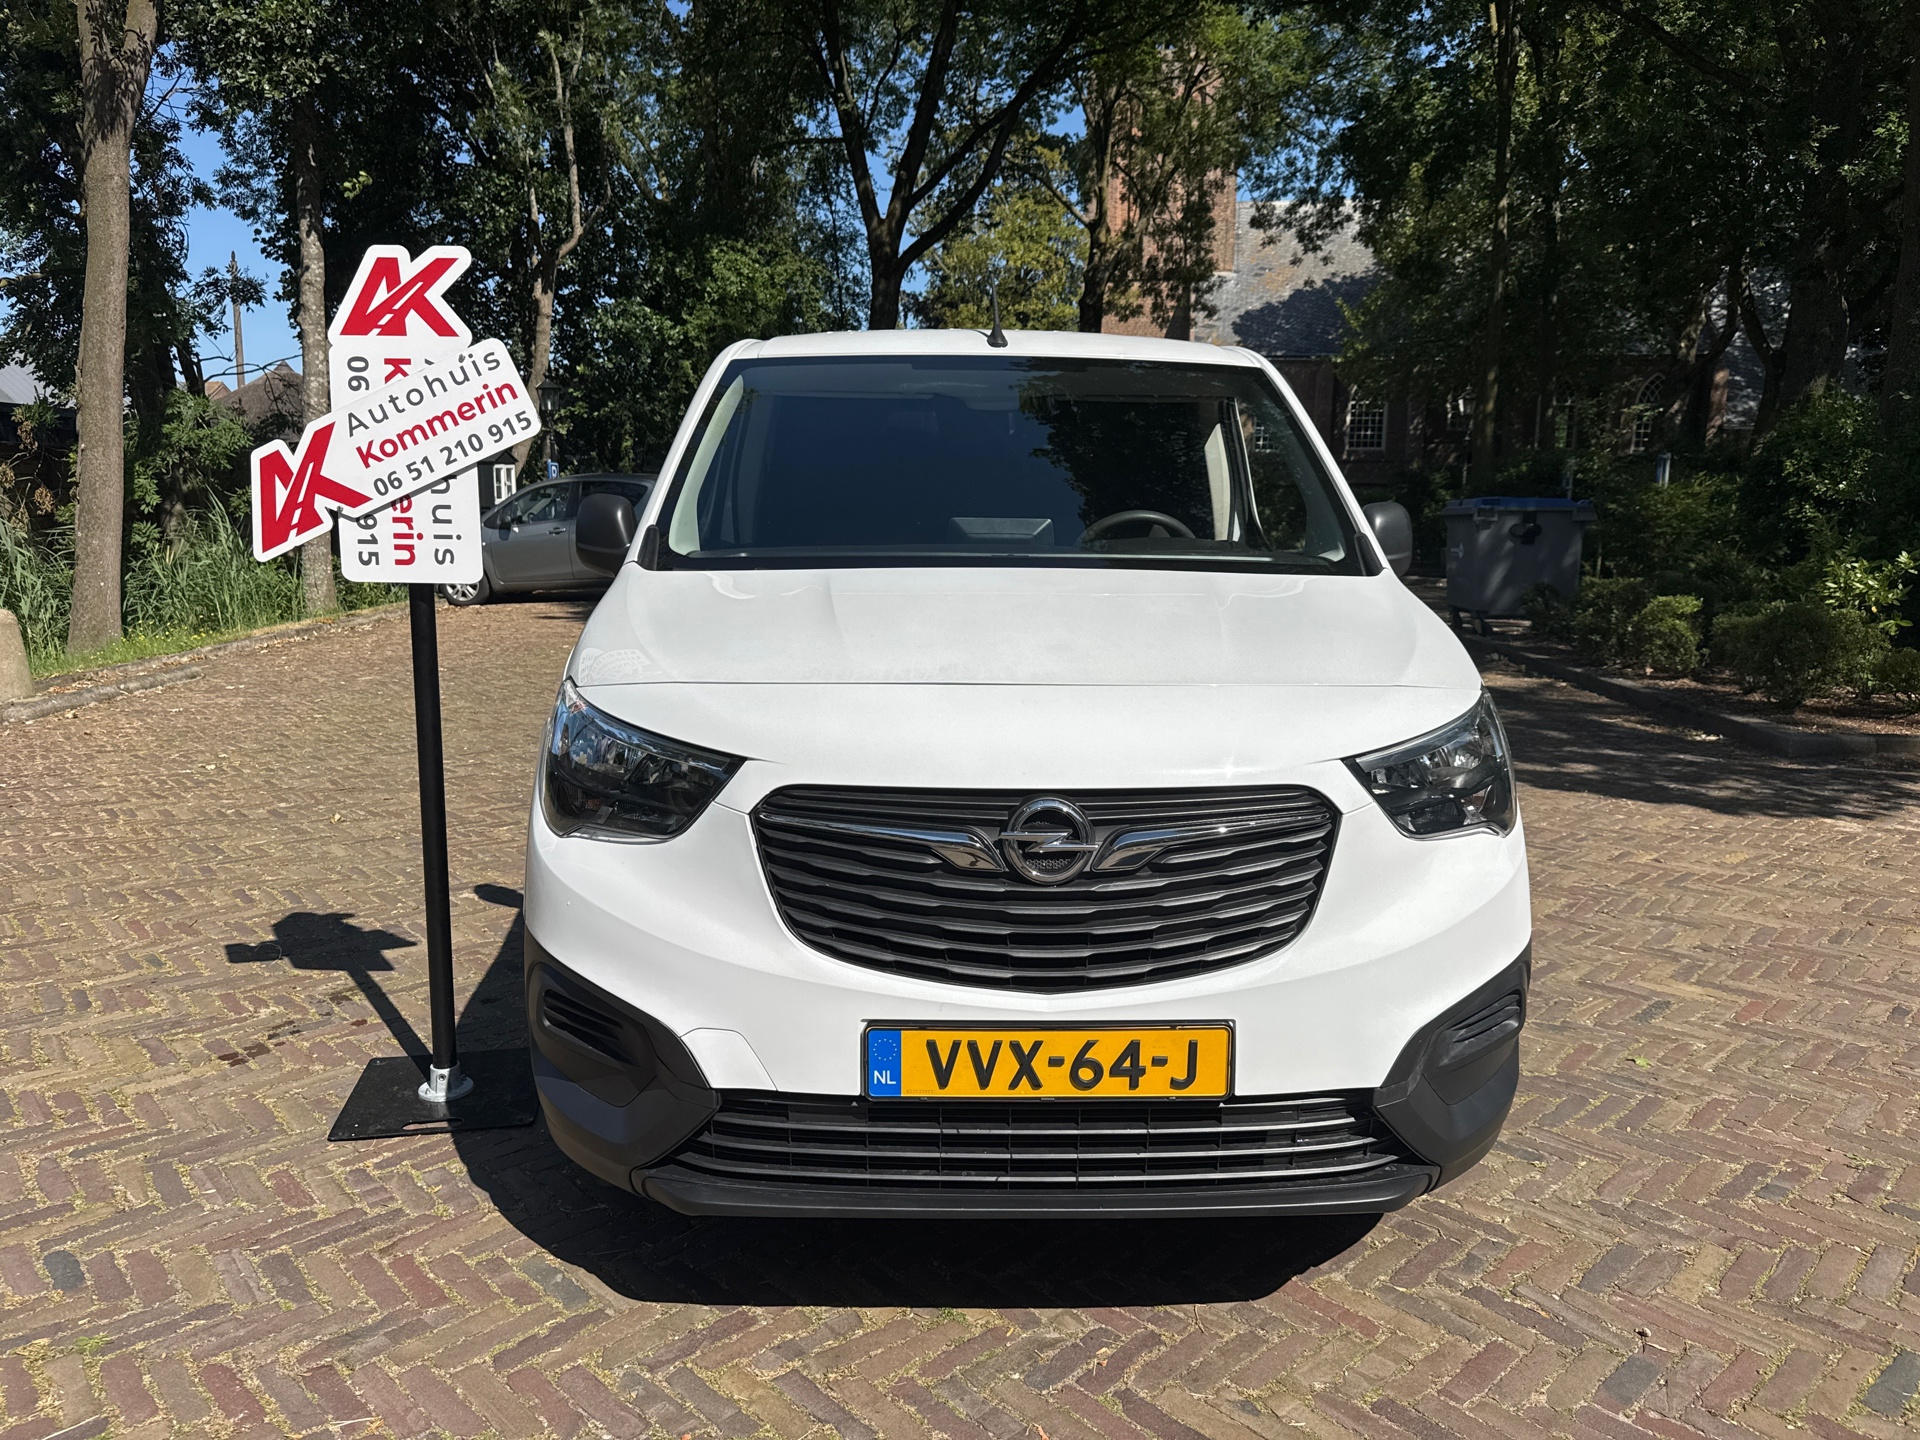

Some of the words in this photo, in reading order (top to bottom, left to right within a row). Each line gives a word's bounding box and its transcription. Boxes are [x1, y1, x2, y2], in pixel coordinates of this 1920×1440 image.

[346, 356, 370, 392] 06
[347, 351, 502, 438] Autohuis
[356, 383, 519, 469] Kommerin
[373, 470, 403, 497] 06
[405, 455, 435, 482] 51
[439, 433, 484, 466] 210
[487, 410, 532, 444] 915
[356, 514, 380, 567] 915
[873, 1070, 897, 1085] NL
[925, 1039, 1198, 1091] VVX-64-J
